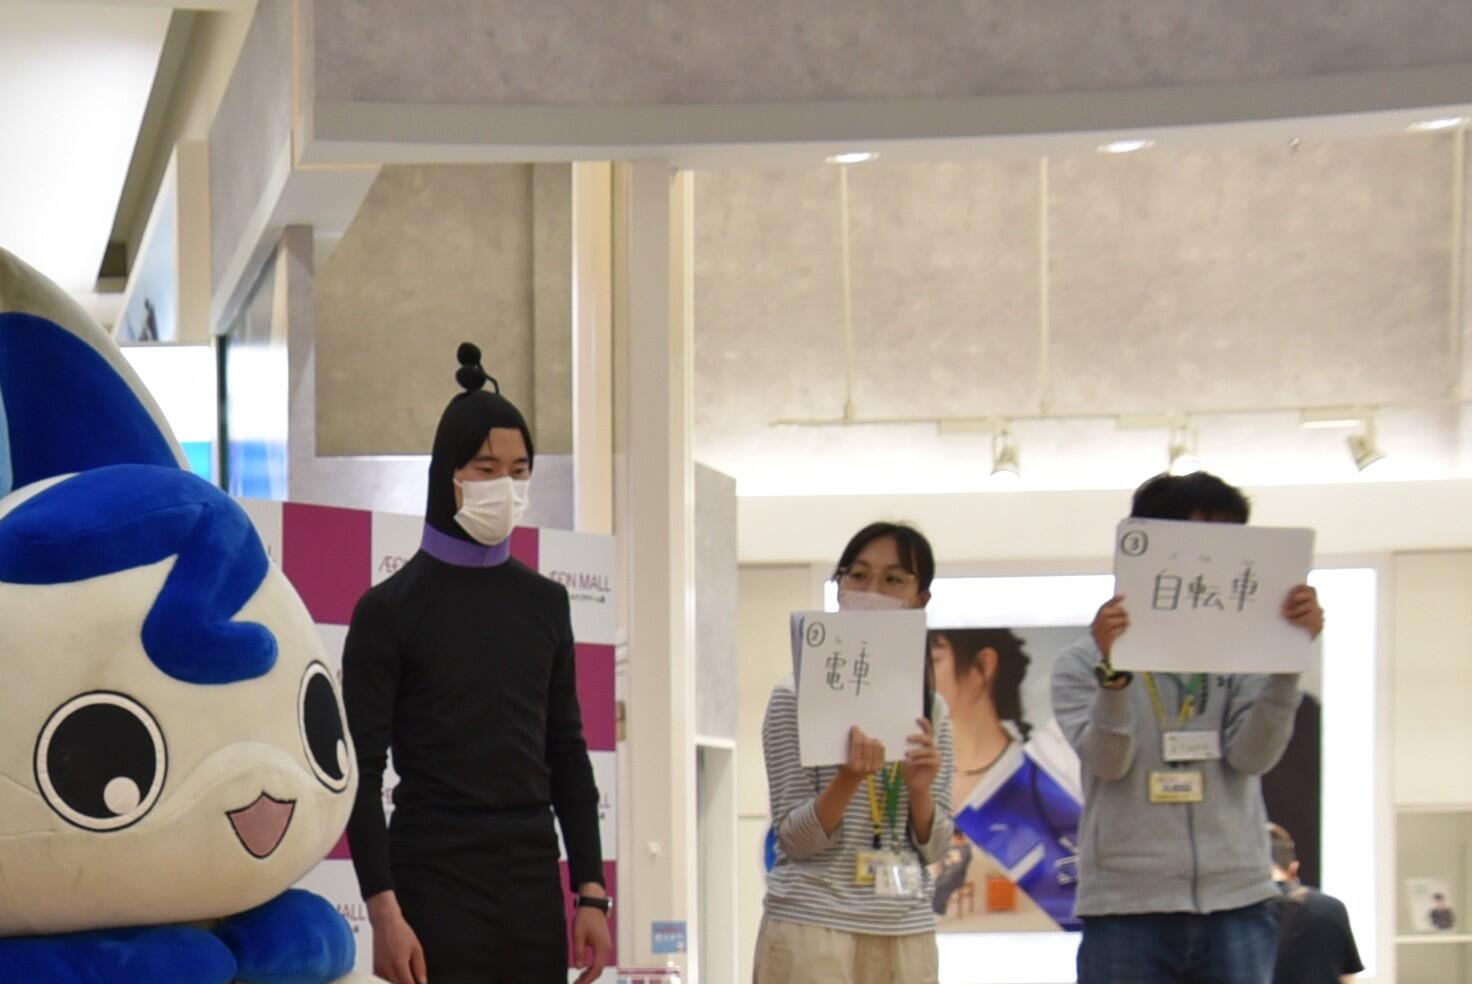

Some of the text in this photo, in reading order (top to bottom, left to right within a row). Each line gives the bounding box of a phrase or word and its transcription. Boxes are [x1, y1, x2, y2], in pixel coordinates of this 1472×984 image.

[579, 573, 612, 592] MALL
[1152, 567, 1259, 612] 自転車
[825, 647, 871, 697] 電車
